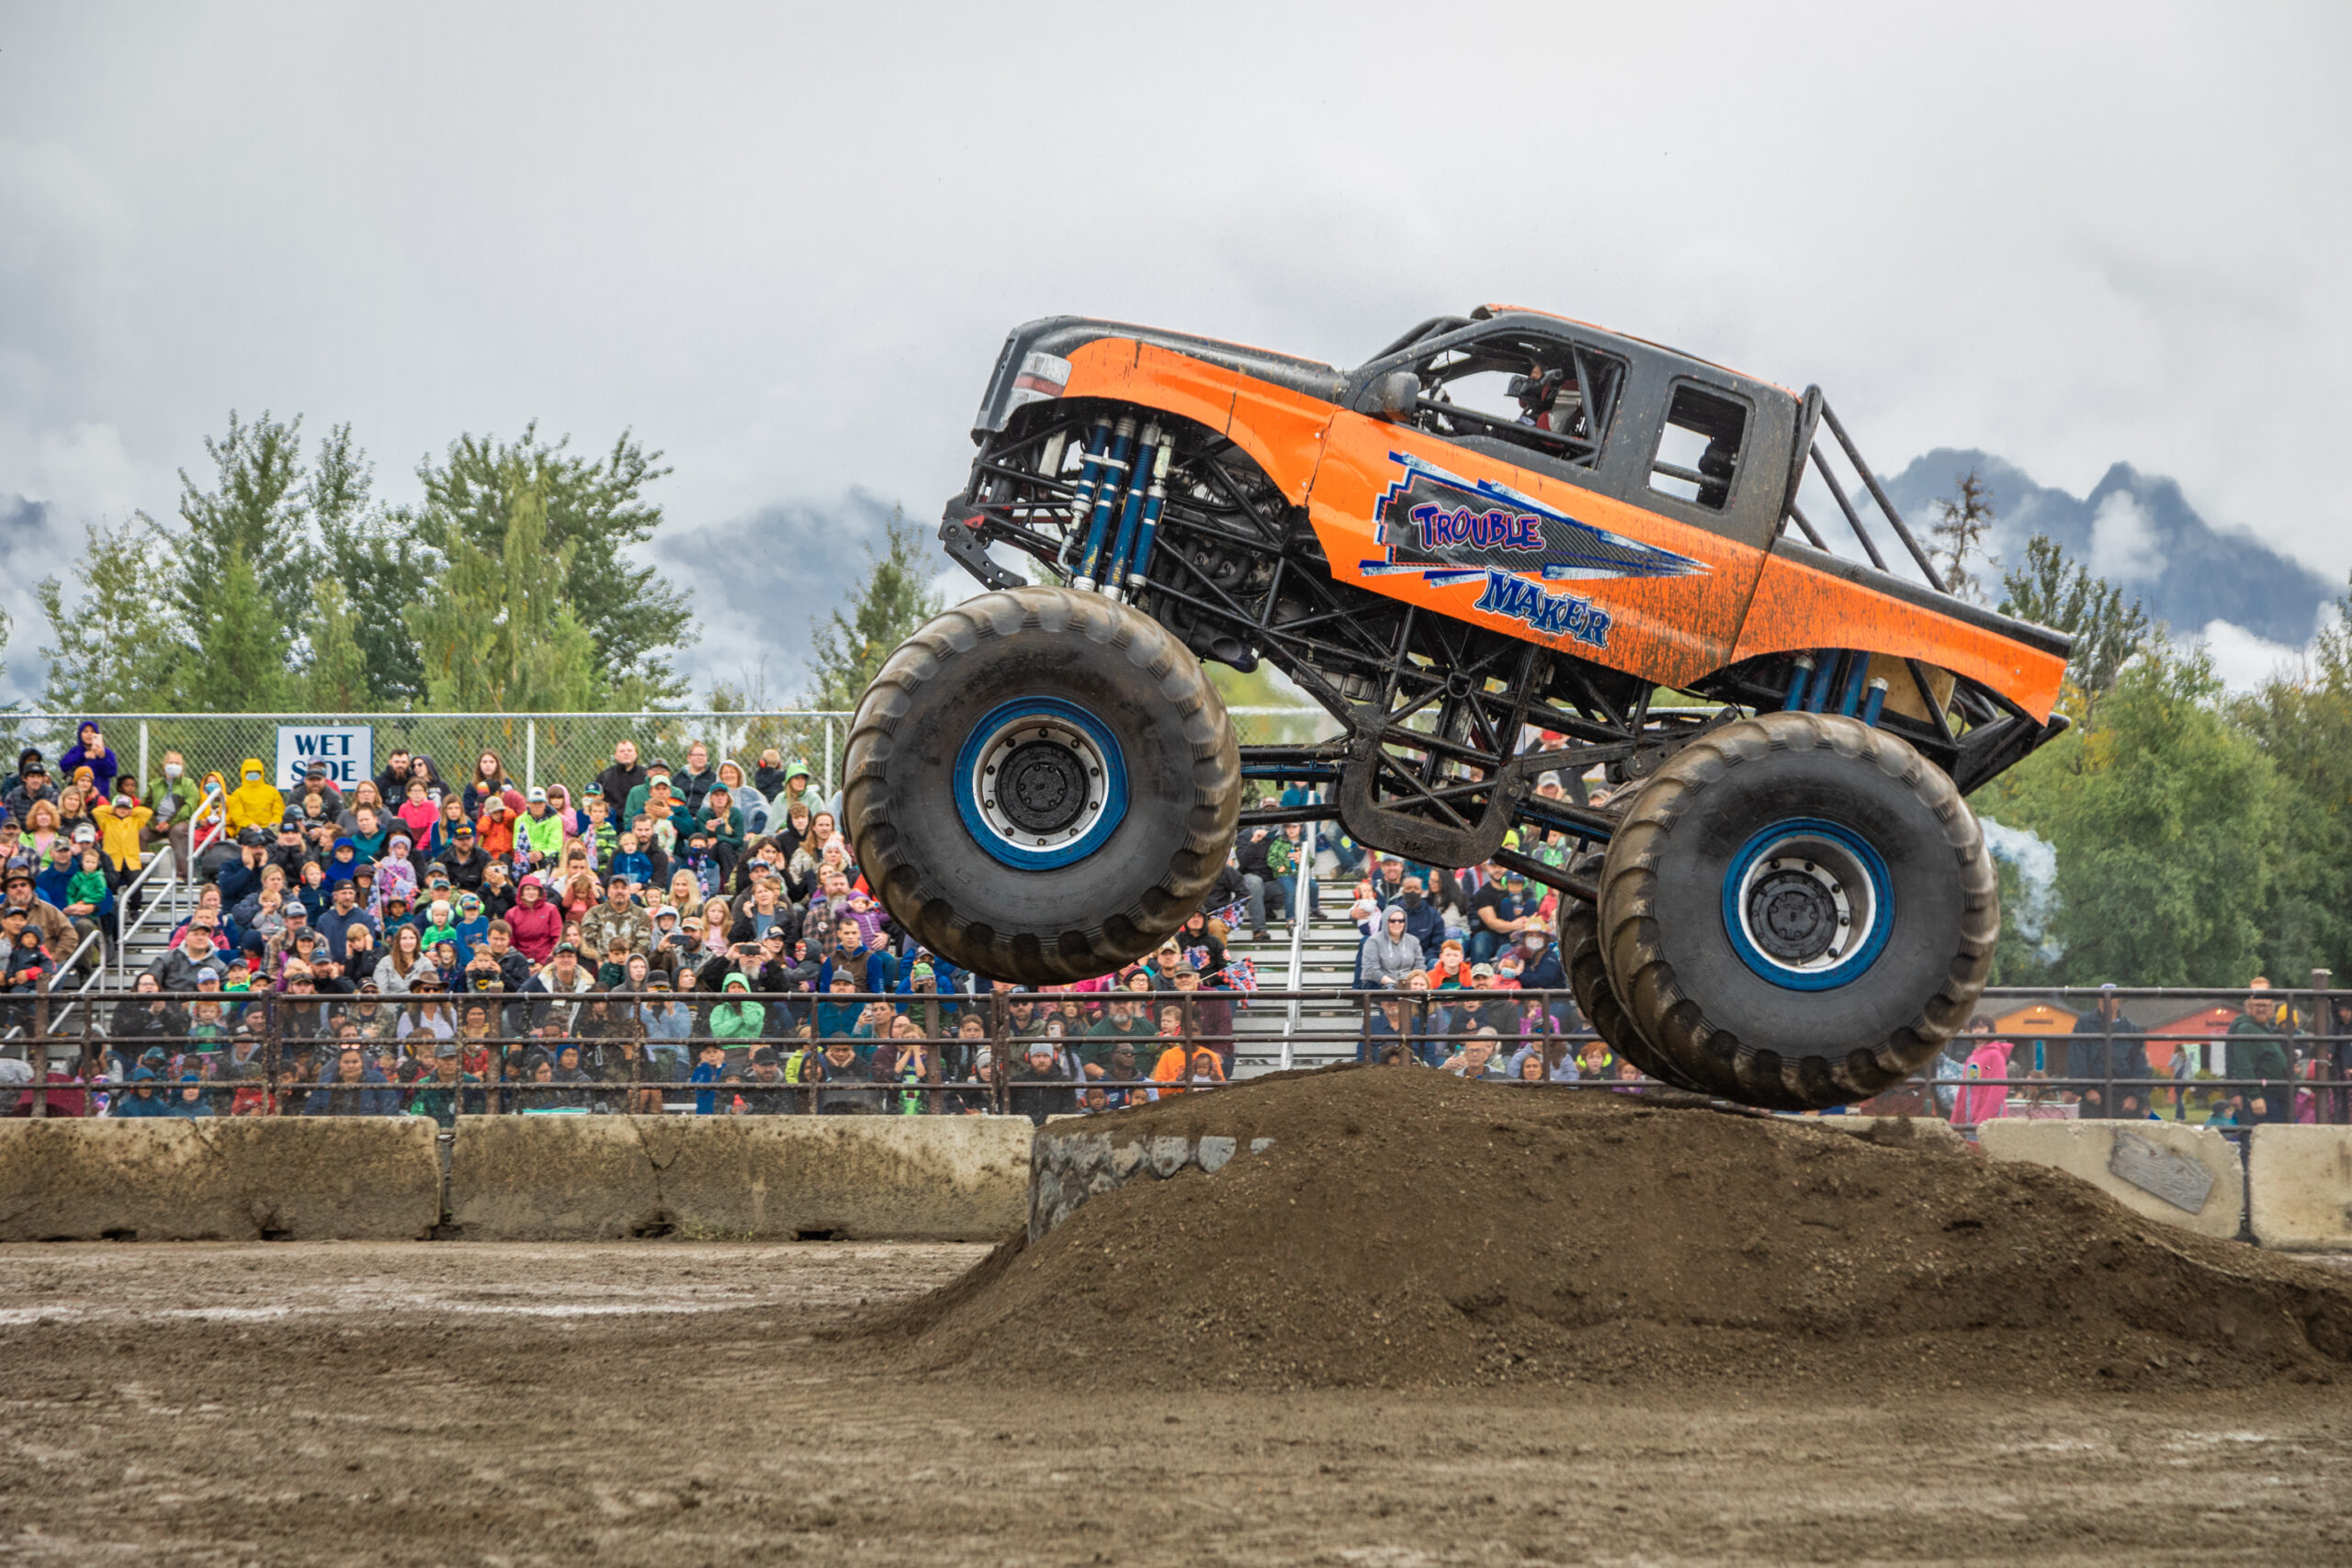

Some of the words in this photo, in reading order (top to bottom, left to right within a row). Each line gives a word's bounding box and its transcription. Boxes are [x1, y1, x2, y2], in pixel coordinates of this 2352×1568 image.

[1410, 503, 1544, 550] TROUBLE
[1476, 568, 1611, 648] MAKER
[294, 734, 354, 756] WET
[290, 760, 357, 783] SDE
